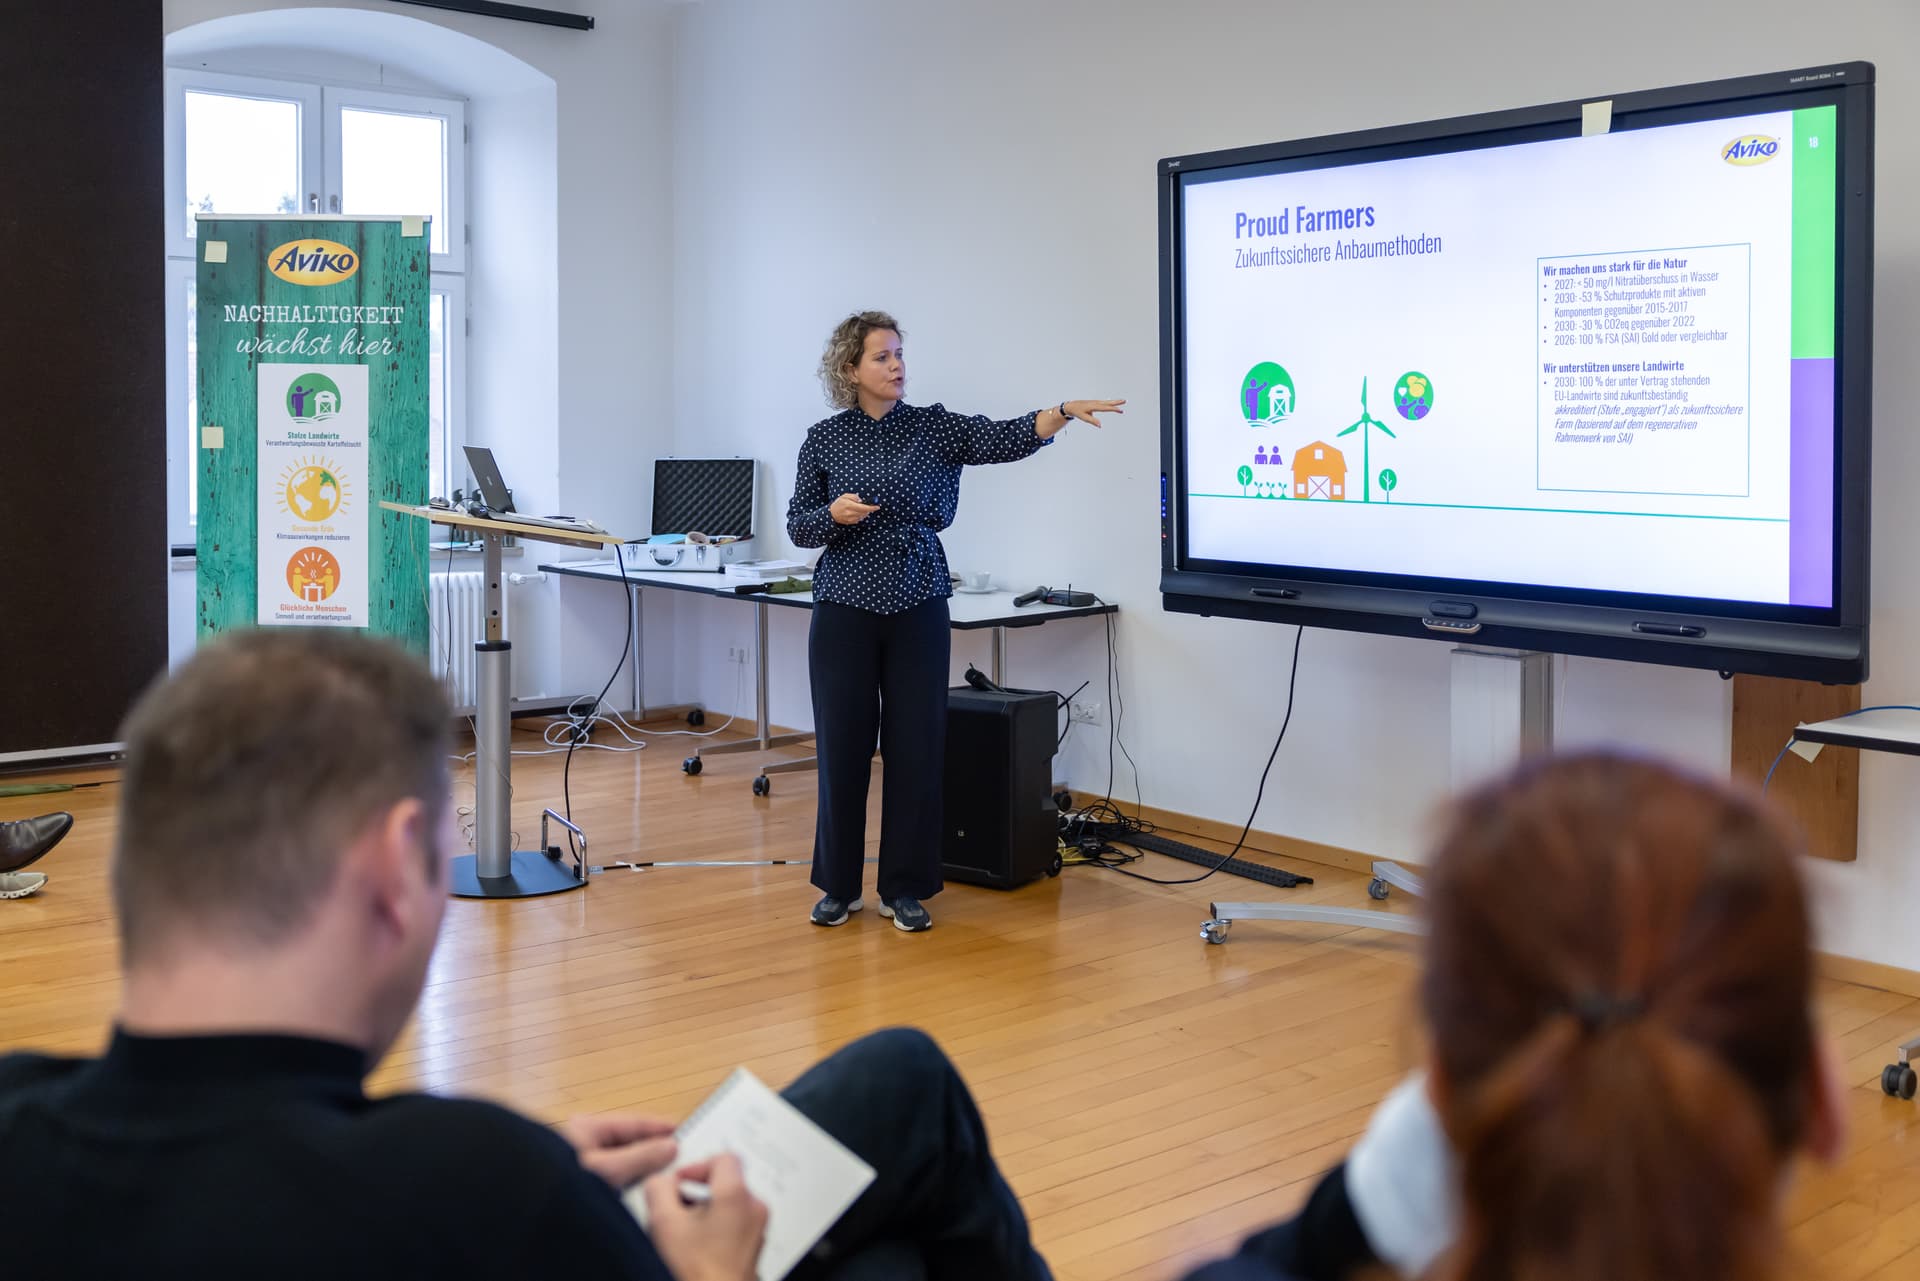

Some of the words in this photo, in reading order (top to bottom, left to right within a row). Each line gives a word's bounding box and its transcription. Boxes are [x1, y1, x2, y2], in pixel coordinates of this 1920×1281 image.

[1809, 136, 1818, 149] 18
[1235, 207, 1289, 239] Proud
[1296, 206, 1375, 233] Farmers
[1235, 243, 1331, 268] Zukunftssichere
[1334, 233, 1442, 260] Anbaumethoden
[1543, 265, 1557, 276] Wir
[1559, 264, 1590, 275] machen
[1592, 265, 1607, 273] uns
[1609, 261, 1630, 272] stark
[1633, 260, 1645, 271] für
[1648, 259, 1661, 270] die
[1664, 258, 1688, 269] Natur
[1554, 279, 1576, 290] 2027:
[1583, 277, 1594, 288] 50
[1595, 276, 1613, 289] mg/l
[1615, 273, 1679, 287] Nitratüberschuss
[1681, 272, 1688, 283] in
[1690, 271, 1719, 282] Wasser
[1554, 292, 1577, 304] 2030:
[1578, 291, 1592, 303] -53
[1594, 291, 1602, 301] %
[1604, 288, 1661, 302] Schutzprodukte
[1663, 287, 1676, 298] mit
[1678, 286, 1706, 298] aktiven
[223, 304, 404, 324] NACHHALTIGKEIT
[1554, 307, 1602, 319] Komponenten
[1604, 304, 1643, 317] gegenüber
[1645, 301, 1688, 314] 2015-2017
[1554, 320, 1577, 331] 2030:
[1578, 320, 1593, 331] -30
[1594, 319, 1602, 330] %
[1604, 319, 1629, 331] CO2eq
[1631, 317, 1670, 330] gegenüber
[1672, 315, 1695, 327] 2022
[236, 328, 332, 356] wächst
[339, 328, 395, 356] hier
[1554, 334, 1577, 345] 2026:
[1579, 334, 1593, 345] 100
[1594, 333, 1603, 344] %
[1605, 333, 1619, 344] FSA
[1621, 332, 1640, 345] (SAI)
[1641, 331, 1659, 343] Gold
[1661, 331, 1677, 342] oder
[1680, 329, 1728, 343] vergleichbar
[1543, 363, 1557, 373] Wir
[1559, 361, 1610, 373] unterstützen
[1612, 363, 1640, 372] unsere
[1642, 360, 1685, 371] Landwirte
[1554, 376, 1577, 387] 2030:
[1579, 376, 1593, 387] 100
[1595, 376, 1603, 386] %
[1605, 376, 1616, 387] der
[1619, 376, 1638, 387] unter
[1640, 375, 1669, 388] Vertrag
[1671, 374, 1710, 386] stehenden
[1554, 390, 1602, 401] EU-Landwirte
[1603, 390, 1618, 400] sind
[1620, 389, 1688, 402] zukunftsbeständig
[1554, 404, 1597, 415] akkreditiert
[1597, 404, 1621, 416] (Stufe
[1667, 404, 1680, 415] als
[1680, 404, 1744, 415] zukunftssichere
[1554, 418, 1574, 429] Farm
[1574, 418, 1613, 431] (basierend
[1613, 418, 1627, 429] auf
[1626, 419, 1644, 429] dem
[1644, 419, 1698, 432] regenerativen
[287, 431, 307, 439] Stolze
[308, 431, 340, 440] Landwirte
[1554, 432, 1601, 443] Rahmenwerk
[1602, 434, 1616, 443] von
[1617, 432, 1634, 445] SAI)
[280, 603, 314, 612] Glückliche
